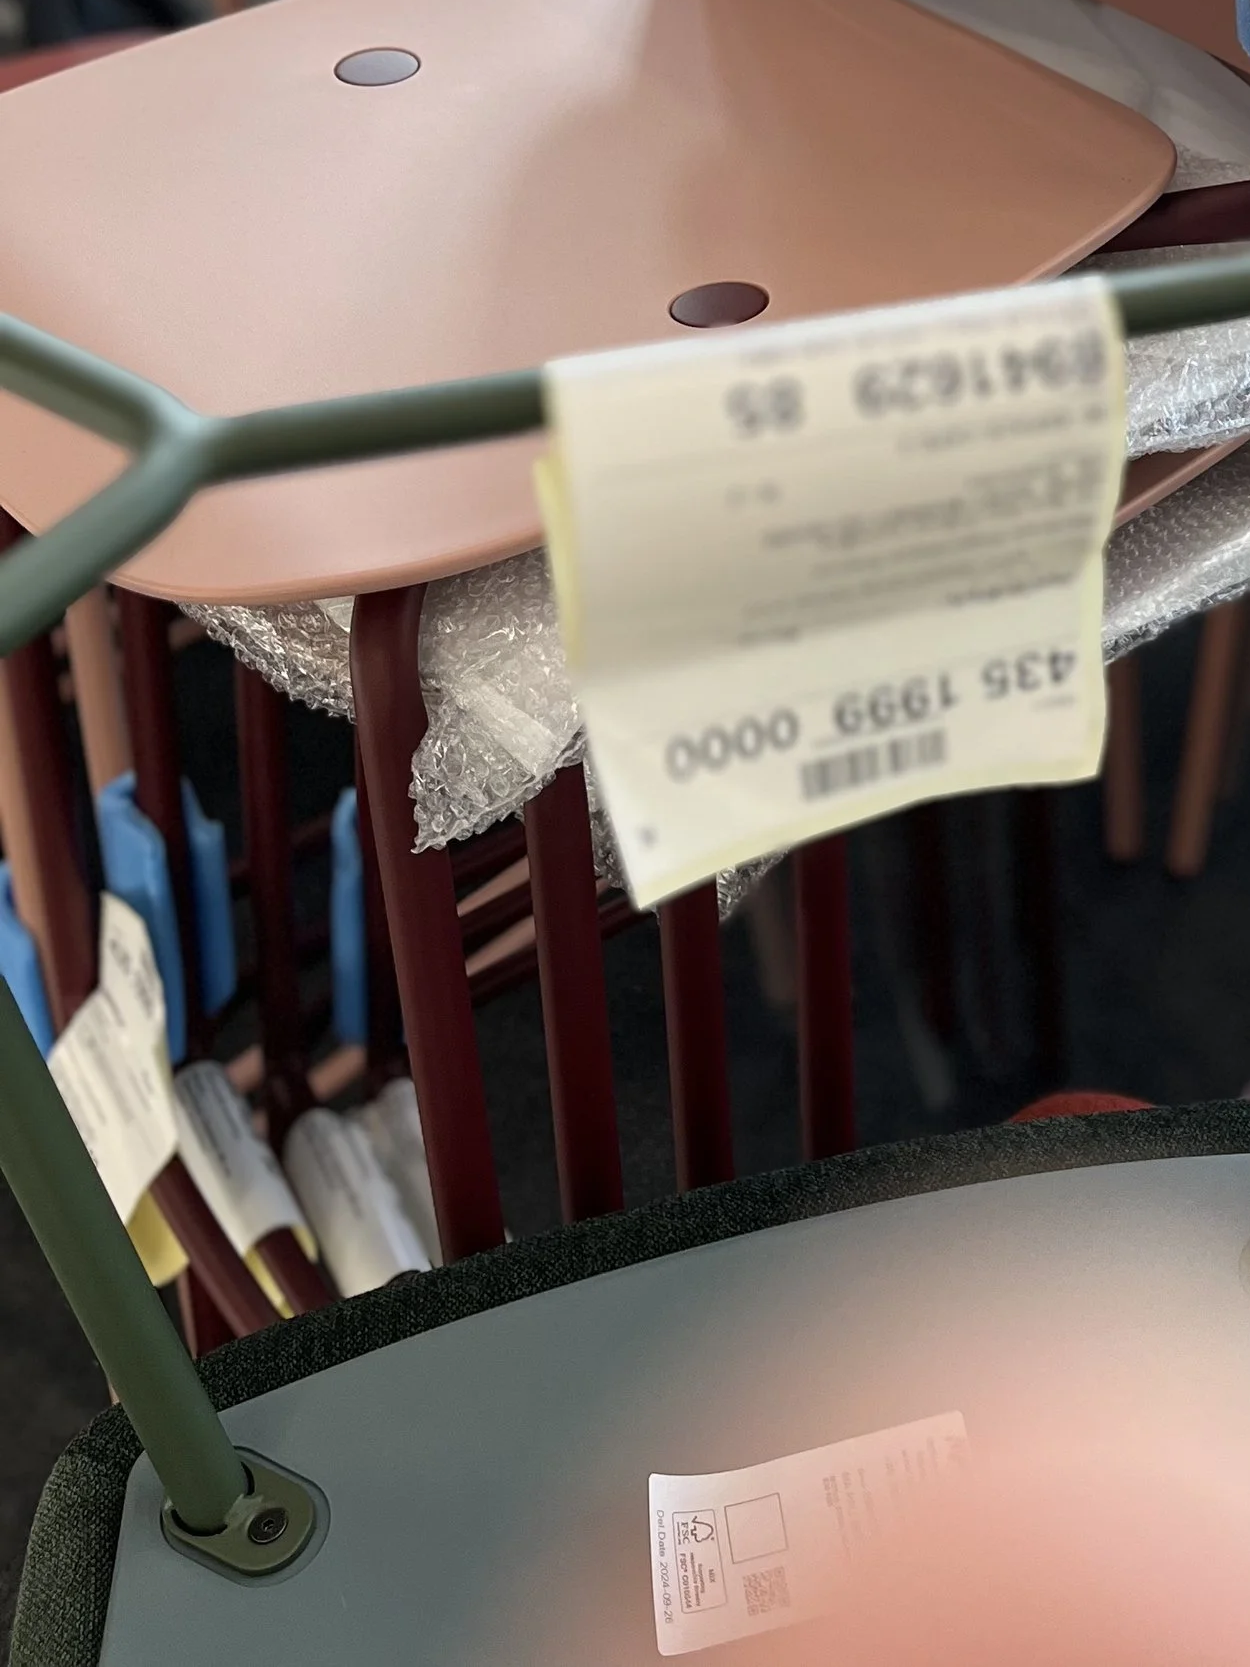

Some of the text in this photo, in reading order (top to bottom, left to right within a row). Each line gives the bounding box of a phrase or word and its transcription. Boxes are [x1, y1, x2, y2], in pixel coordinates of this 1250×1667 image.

[663, 648, 1077, 782] 435 1999 0000
[680, 1522, 691, 1545] FSC
[660, 1562, 674, 1624] 2024-09-26
